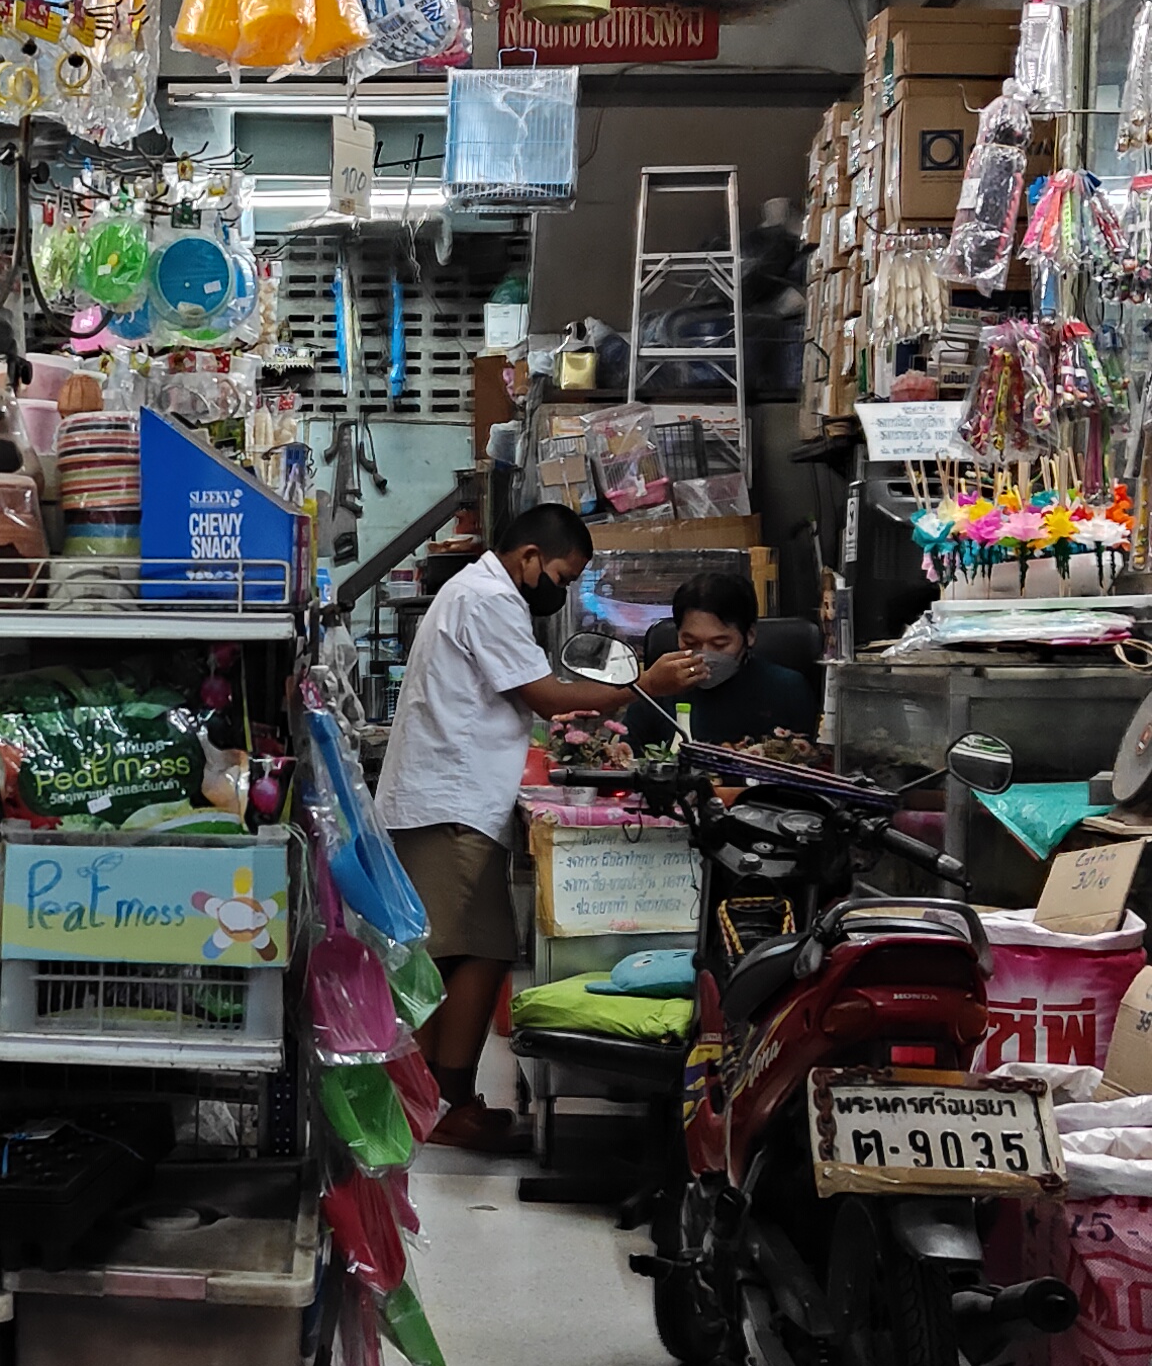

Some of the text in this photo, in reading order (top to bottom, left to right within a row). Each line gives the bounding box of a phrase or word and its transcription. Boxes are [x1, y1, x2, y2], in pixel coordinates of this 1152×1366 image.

[341, 167, 367, 194] 100
[189, 490, 233, 504] SLEEKY
[188, 513, 244, 536] CHEWY
[191, 536, 242, 559] SNACK
[28, 853, 186, 932] Peat moss
[892, 992, 939, 1001] HONDA
[834, 1090, 1017, 1123] พระนครศรีอยุธยา
